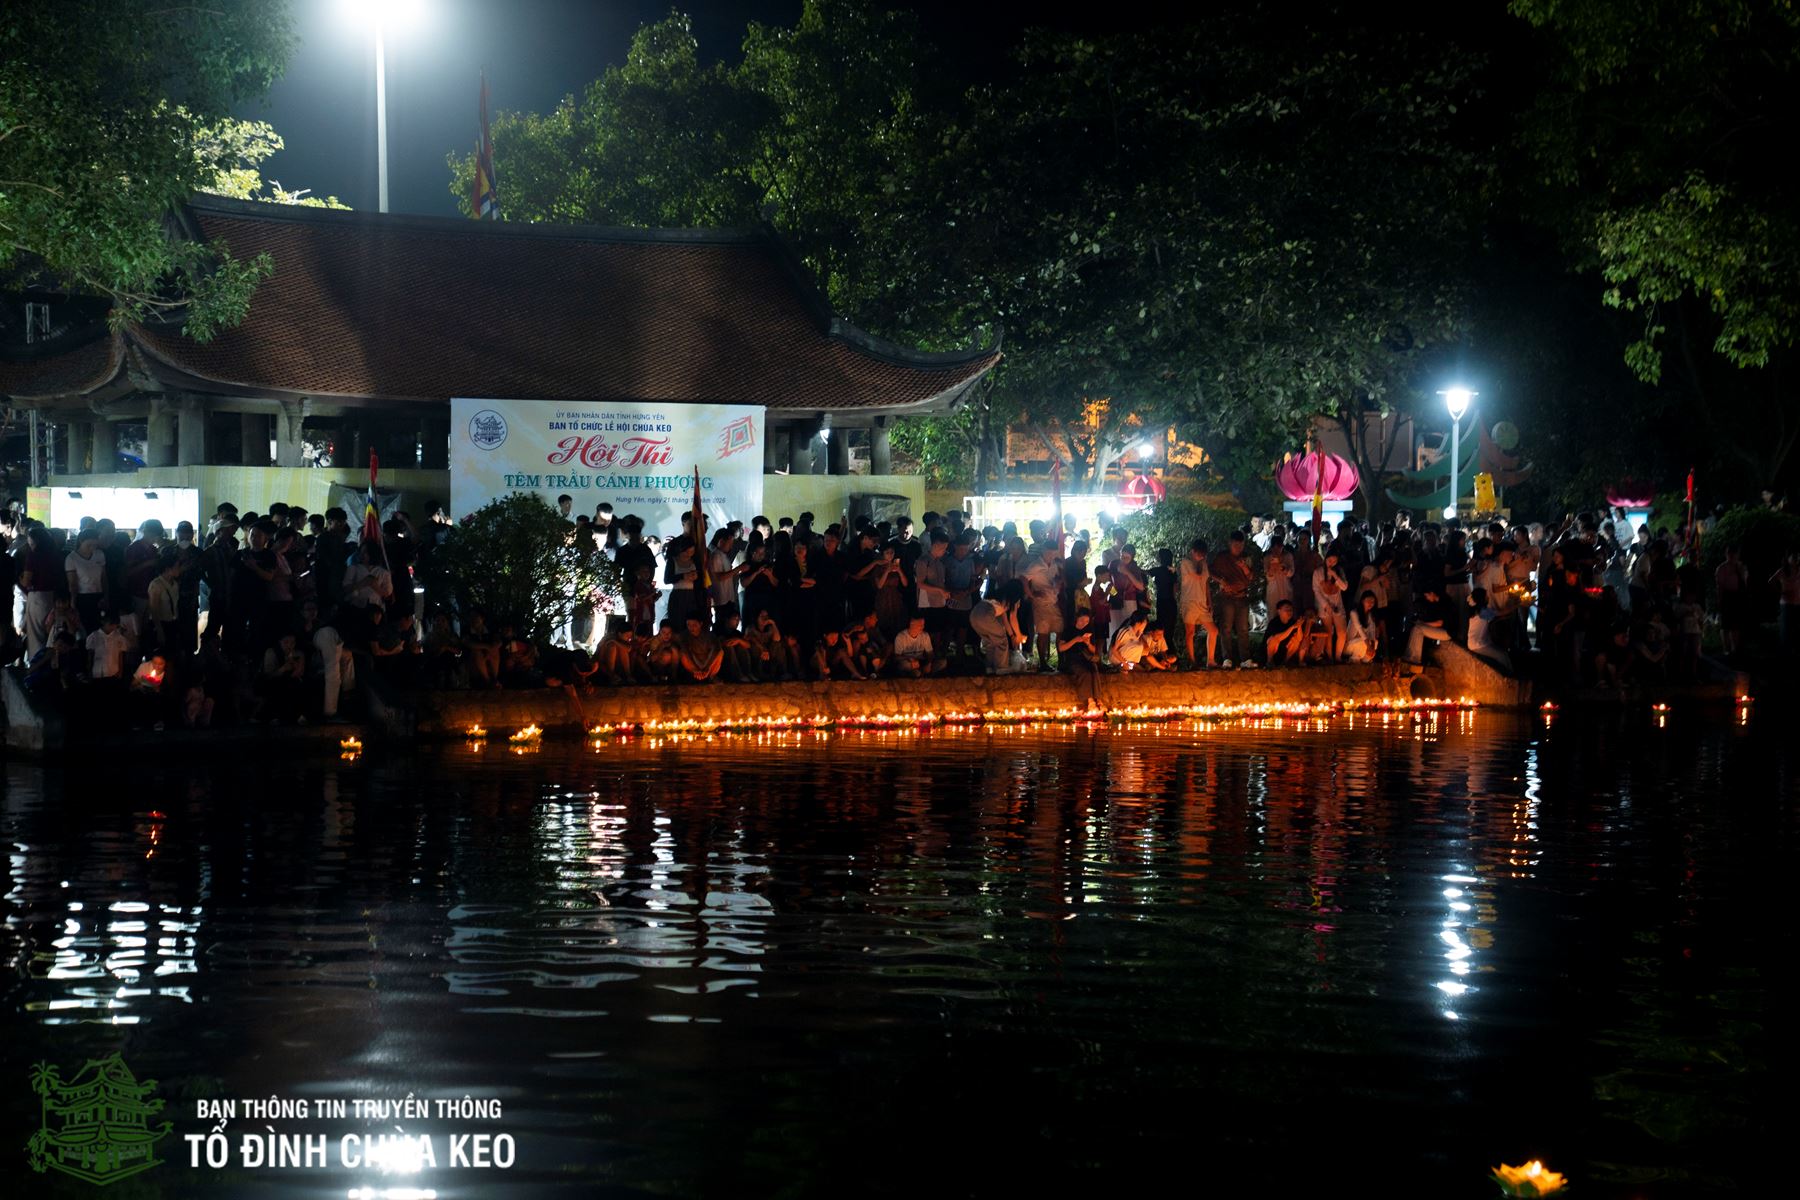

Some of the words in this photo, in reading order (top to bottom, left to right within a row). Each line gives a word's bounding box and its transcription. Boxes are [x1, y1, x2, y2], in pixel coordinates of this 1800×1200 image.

[582, 411, 600, 419] NHÂN
[602, 411, 615, 420] DÂN
[616, 410, 631, 420] TỈNH
[633, 412, 650, 420] HƯNG
[653, 411, 665, 421] YÊN
[549, 422, 566, 430] BAN
[581, 421, 603, 431] CHỨC
[616, 422, 630, 433] HỘI
[656, 423, 672, 433] KEO
[547, 434, 621, 469] Hội
[619, 436, 673, 469] Thi
[504, 472, 540, 489] TÊM
[545, 468, 590, 489] TRẦU
[595, 472, 640, 489] CÁNH
[616, 496, 632, 504] Hưng
[648, 497, 662, 505] ngày
[672, 496, 689, 505] tháng
